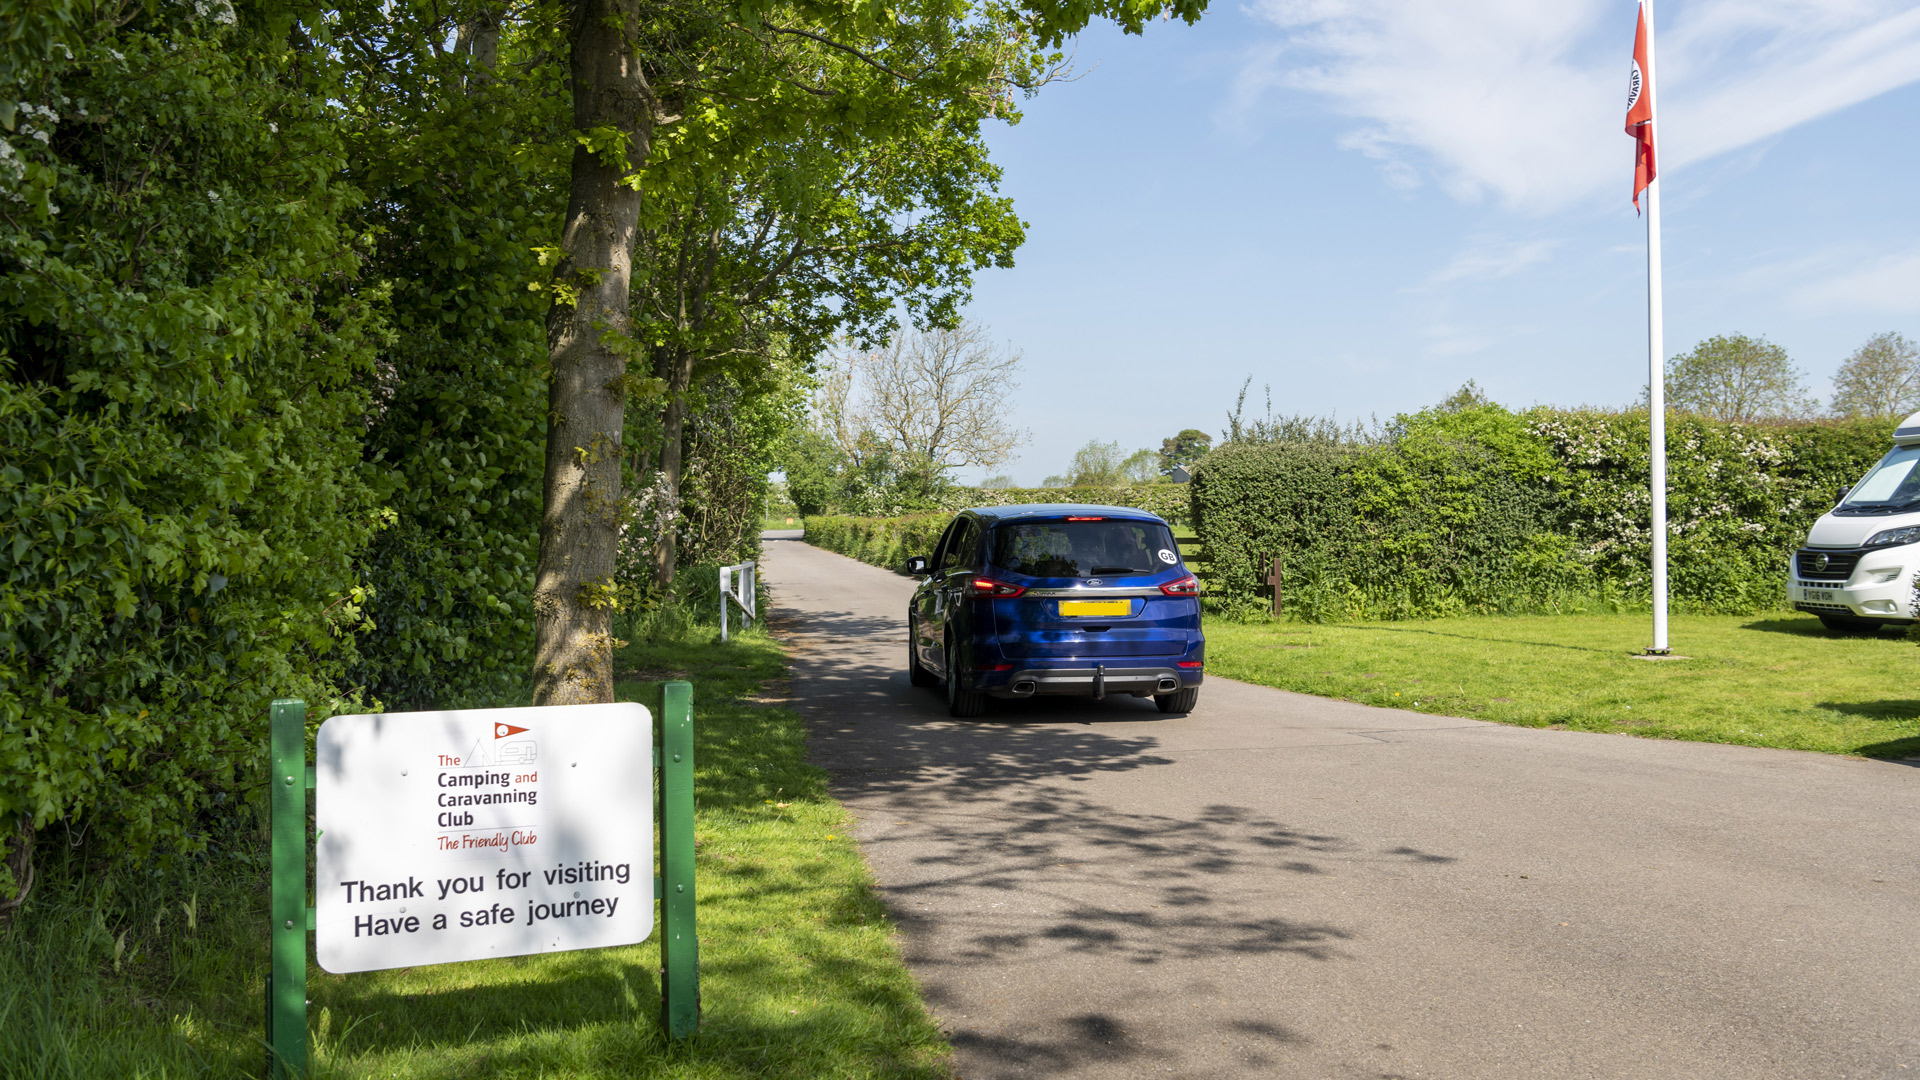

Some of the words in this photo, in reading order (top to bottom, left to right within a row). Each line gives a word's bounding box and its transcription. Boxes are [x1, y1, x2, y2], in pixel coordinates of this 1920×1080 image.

[1160, 552, 1175, 562] GB
[438, 755, 460, 766] The
[438, 771, 510, 788] Camping
[515, 772, 537, 783] and
[438, 789, 537, 807] Caravanning
[438, 811, 473, 827] Club
[438, 837, 459, 850] The
[463, 833, 508, 852] Friendly
[512, 831, 536, 845] Club
[341, 877, 424, 903] Thank
[438, 876, 483, 900] you
[496, 869, 531, 889] for
[544, 861, 630, 885] visiting
[355, 915, 419, 937] Have
[433, 914, 446, 930] a
[460, 904, 514, 927] safe
[527, 896, 618, 926] journey
